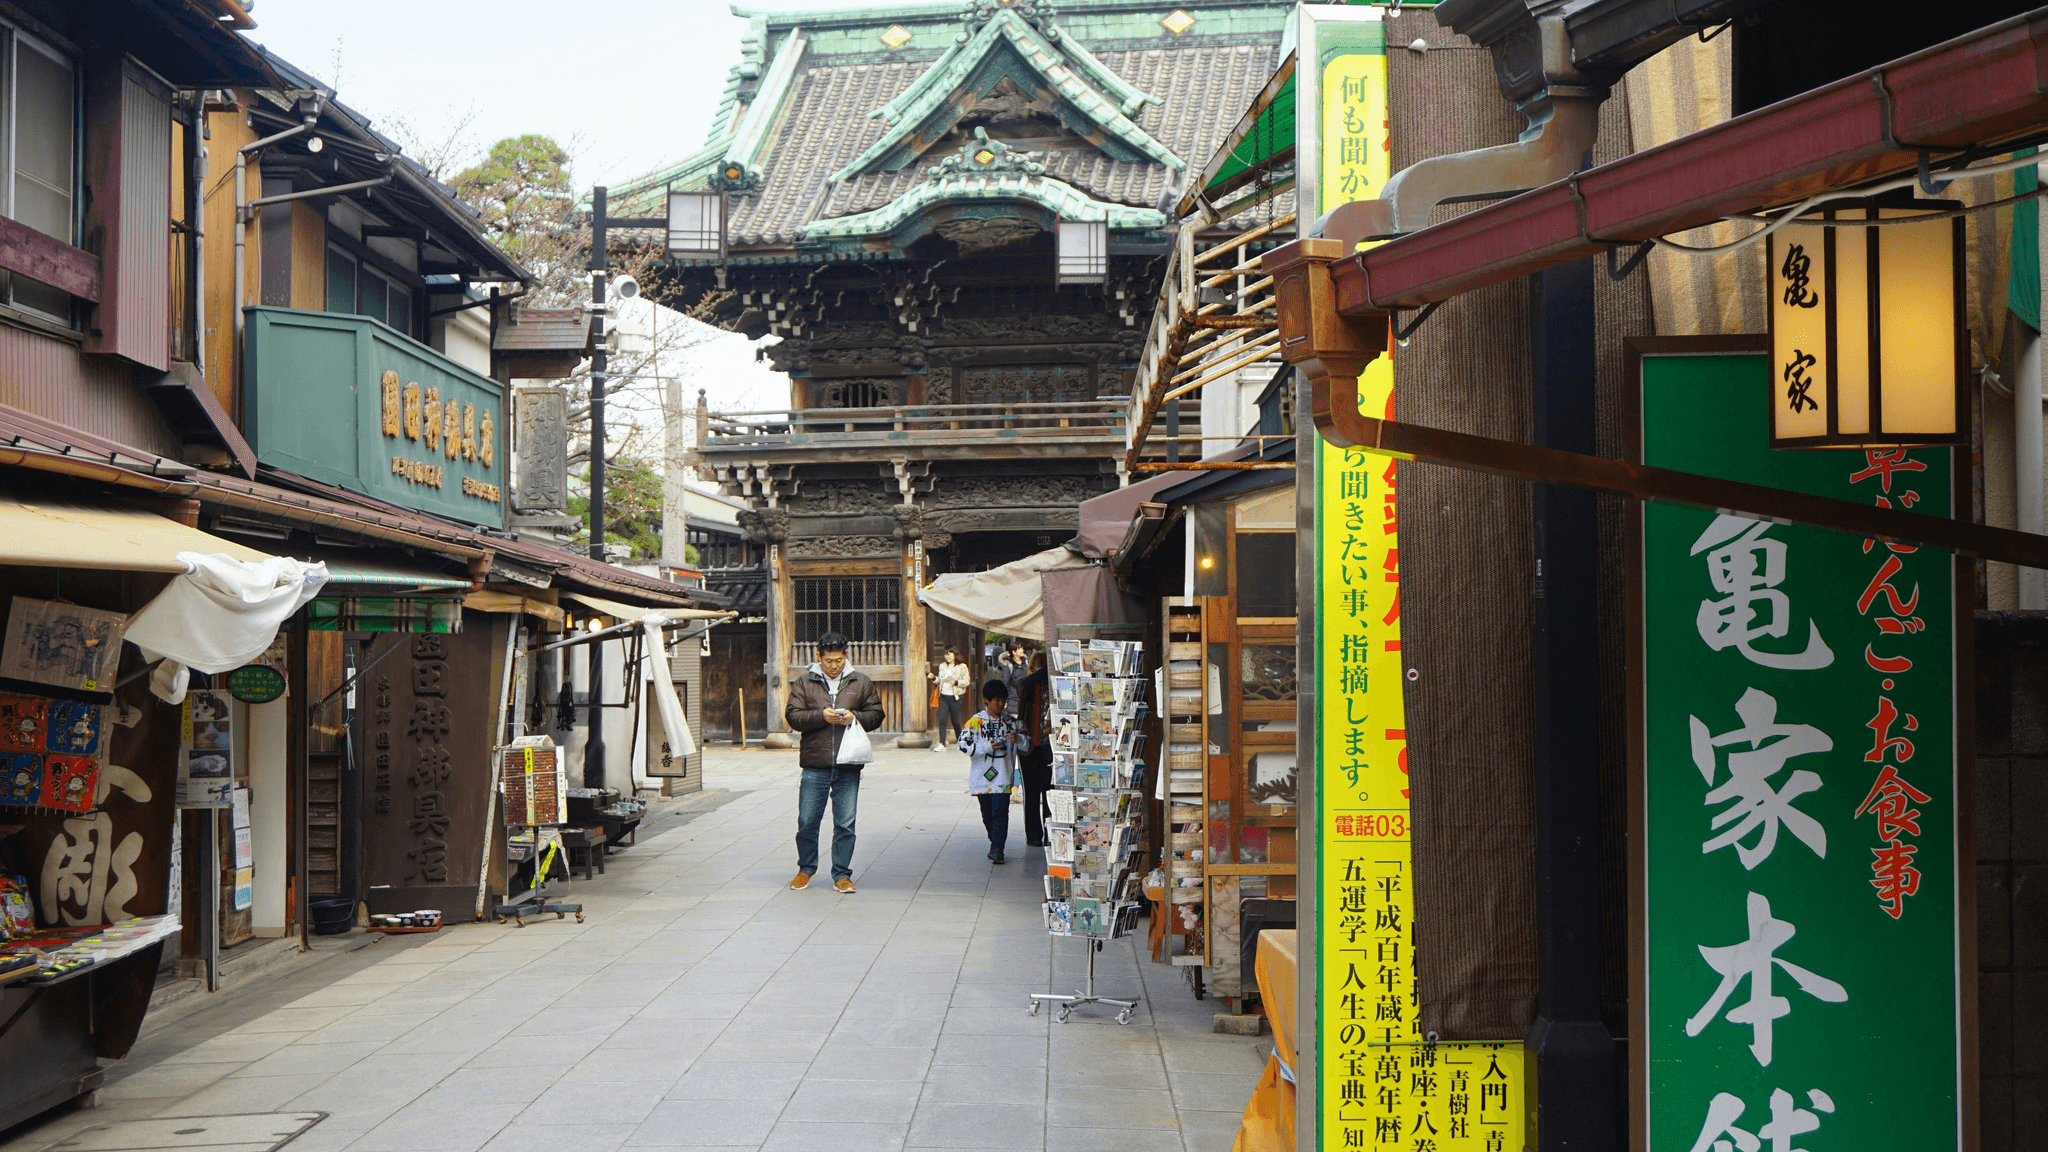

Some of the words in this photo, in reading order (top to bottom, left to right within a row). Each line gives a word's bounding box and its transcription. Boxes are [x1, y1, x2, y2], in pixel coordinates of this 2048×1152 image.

[1781, 243, 1819, 415] 亀家
[1338, 856, 1368, 1152] 五運学「人生の宝典」知
[1374, 860, 1403, 1152] 「平成百年蔵干萬年暦
[1445, 1044, 1473, 1139] 」青樹社
[1480, 1044, 1508, 1152] 入門」青
